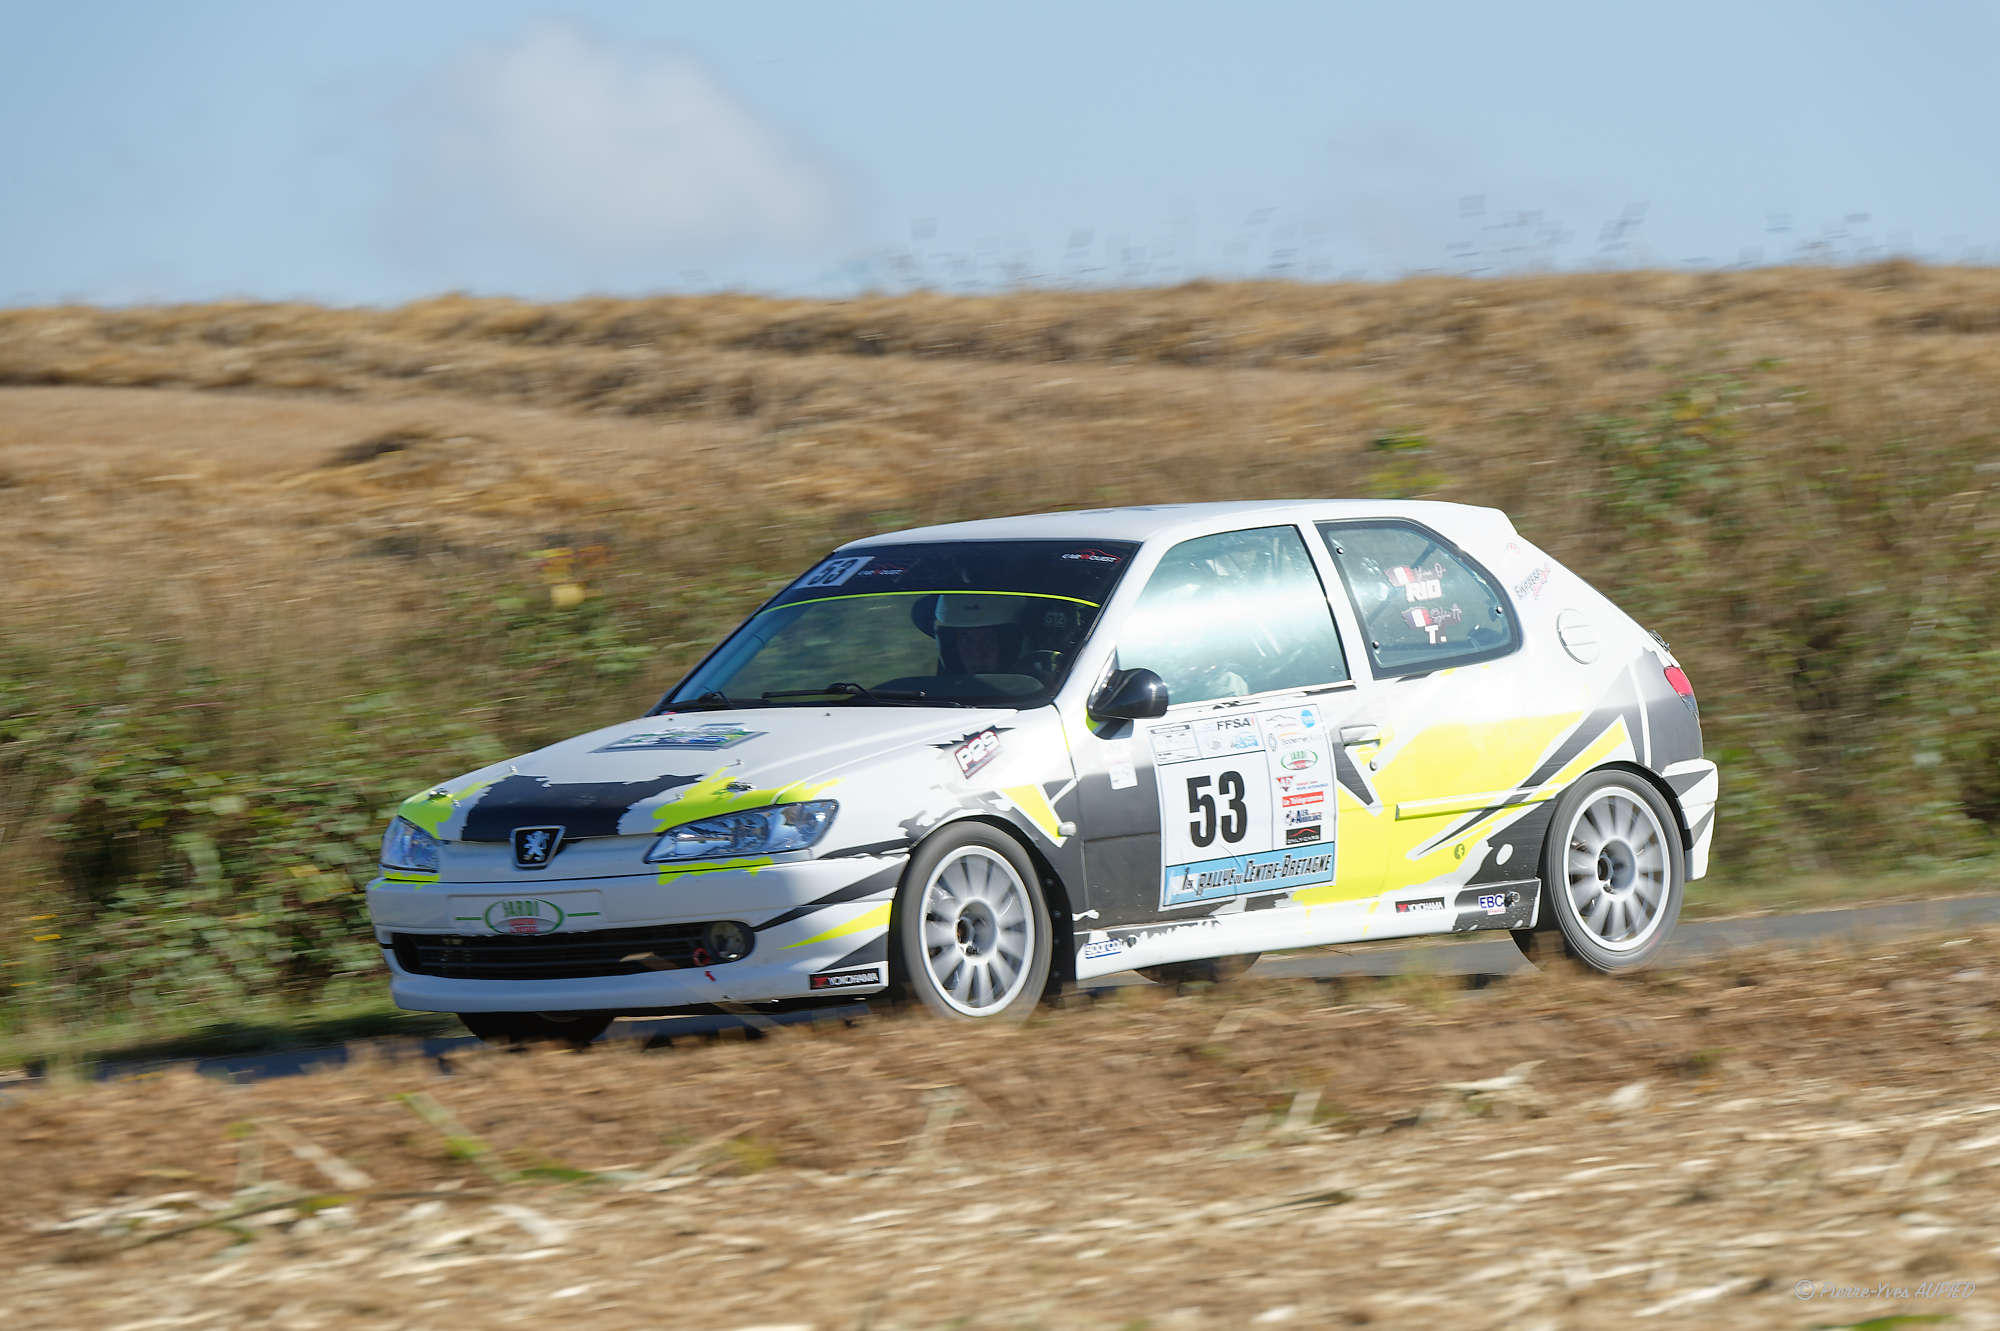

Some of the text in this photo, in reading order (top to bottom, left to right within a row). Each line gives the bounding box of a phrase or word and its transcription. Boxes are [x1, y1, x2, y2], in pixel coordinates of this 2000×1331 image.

[807, 559, 858, 585] 53
[1216, 718, 1250, 731] FFSA
[1186, 770, 1248, 848] 53
[1479, 894, 1504, 909] EBC
